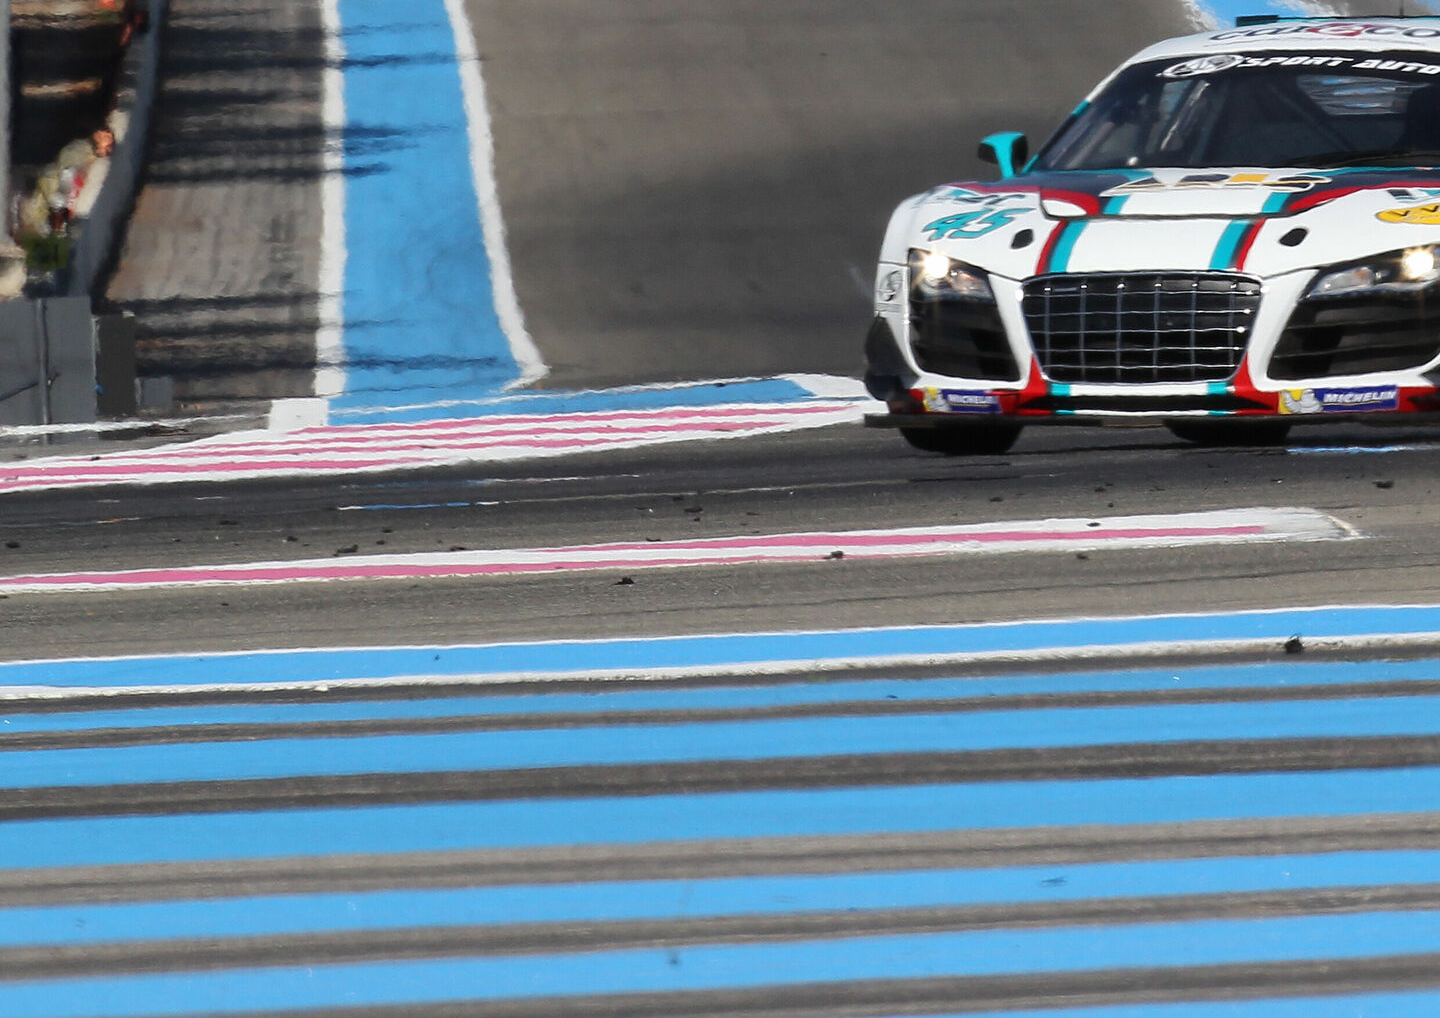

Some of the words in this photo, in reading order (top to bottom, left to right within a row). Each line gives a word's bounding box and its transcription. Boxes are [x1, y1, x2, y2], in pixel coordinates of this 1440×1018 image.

[1237, 55, 1354, 68] SPORT
[920, 207, 1036, 242] 45
[1322, 390, 1397, 403] MICHELIN
